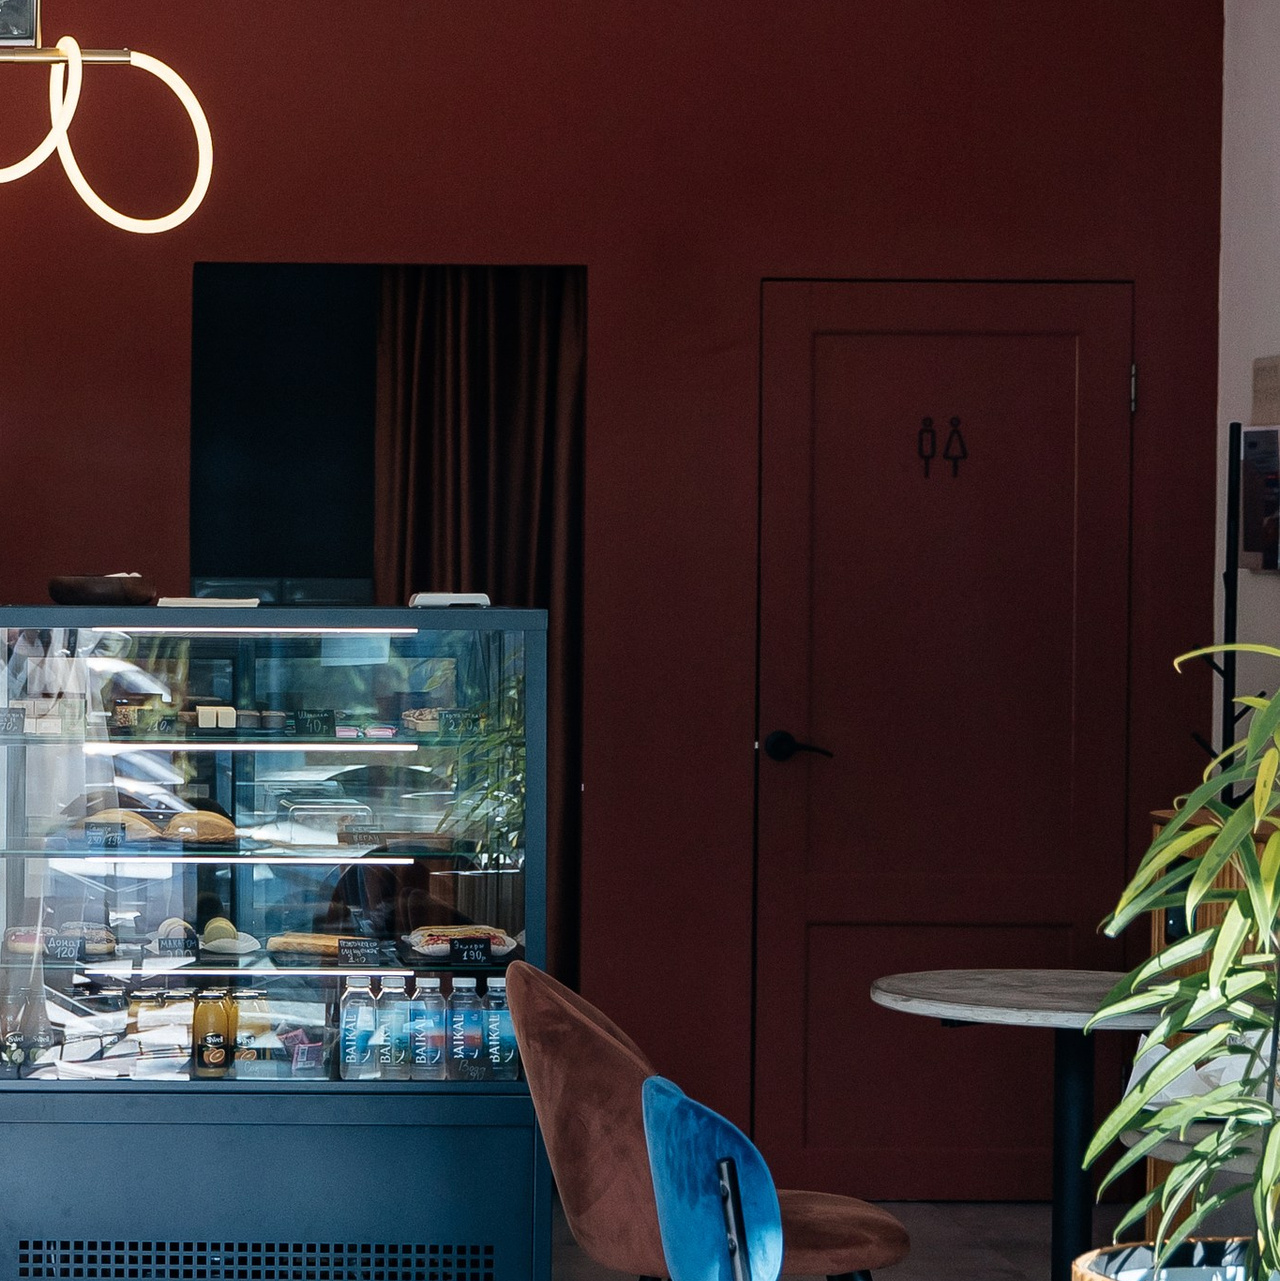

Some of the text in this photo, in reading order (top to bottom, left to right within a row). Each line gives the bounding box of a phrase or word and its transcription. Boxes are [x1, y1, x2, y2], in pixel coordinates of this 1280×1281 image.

[47, 937, 83, 947] Донат
[346, 1014, 357, 1063] BAIKAL
[489, 1014, 500, 1063] BAIKAL
